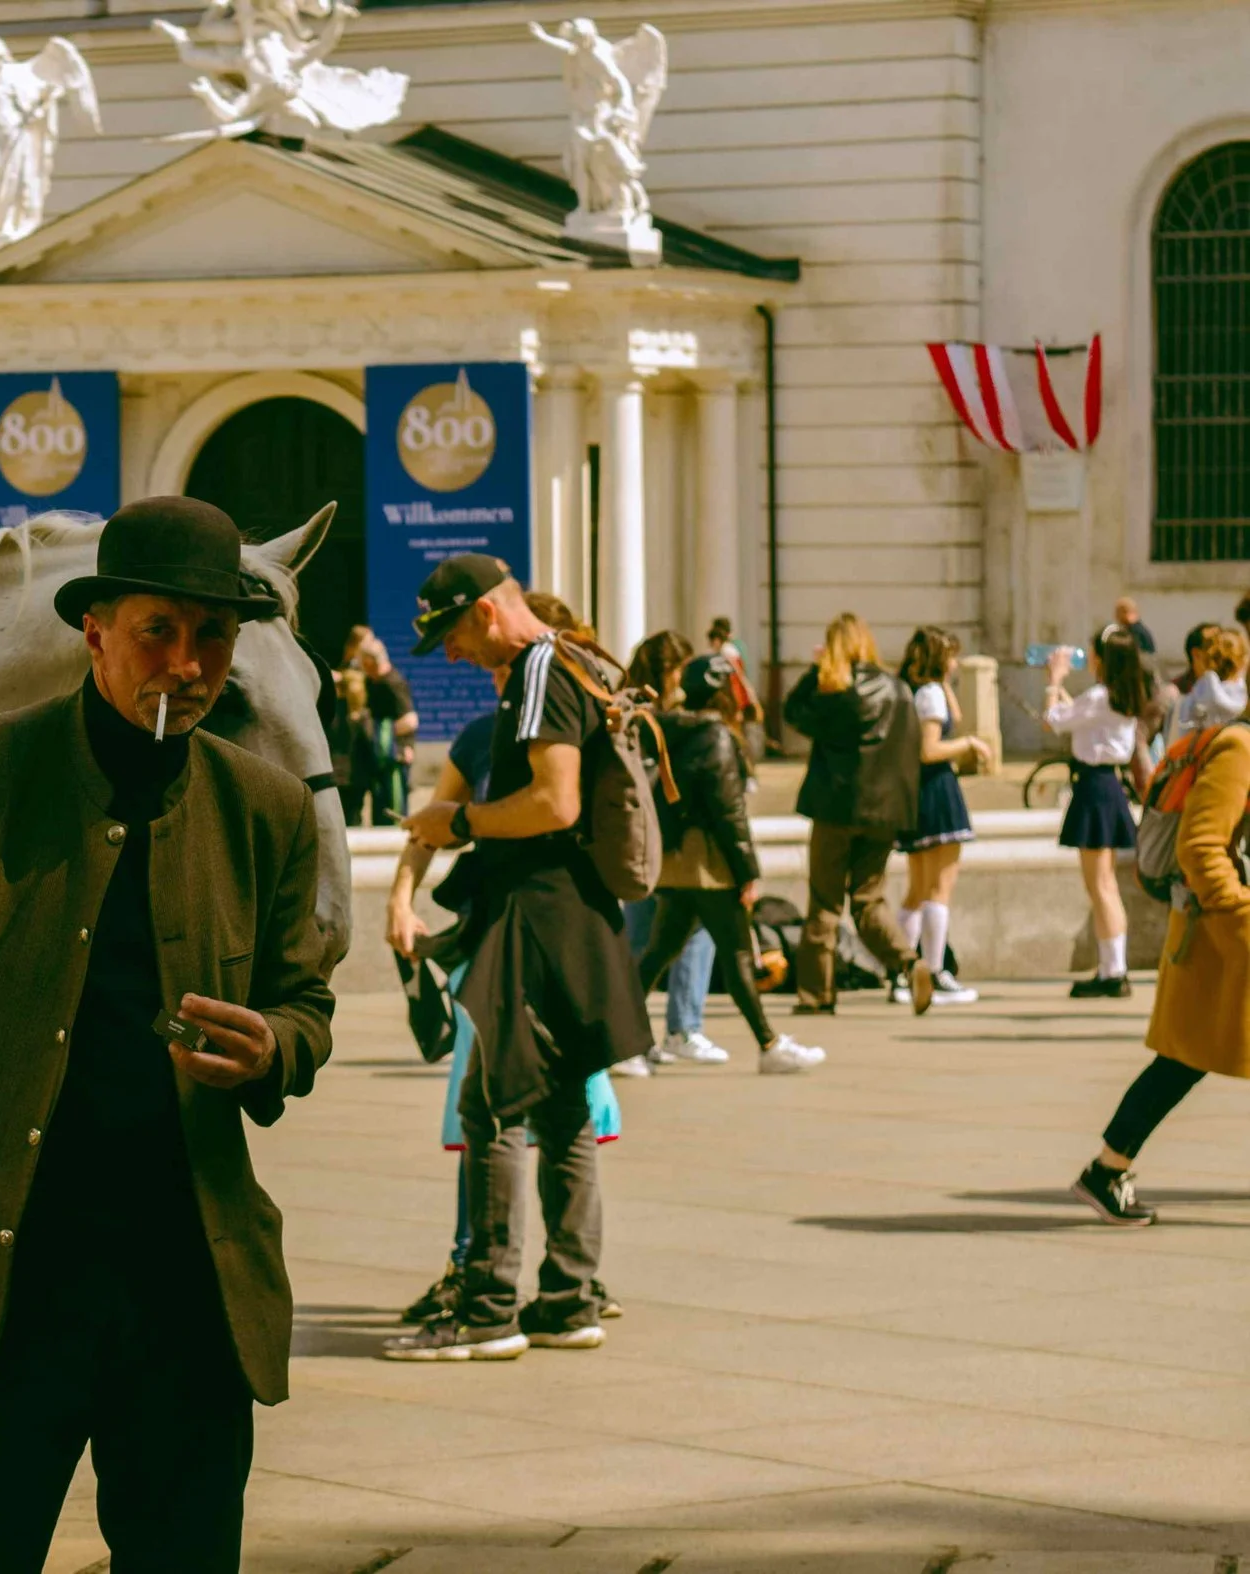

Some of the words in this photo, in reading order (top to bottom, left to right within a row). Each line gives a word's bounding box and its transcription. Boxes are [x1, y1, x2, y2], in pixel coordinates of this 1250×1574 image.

[0, 412, 83, 458] 800
[402, 405, 494, 451] 800
[382, 500, 515, 526] Willkommen
